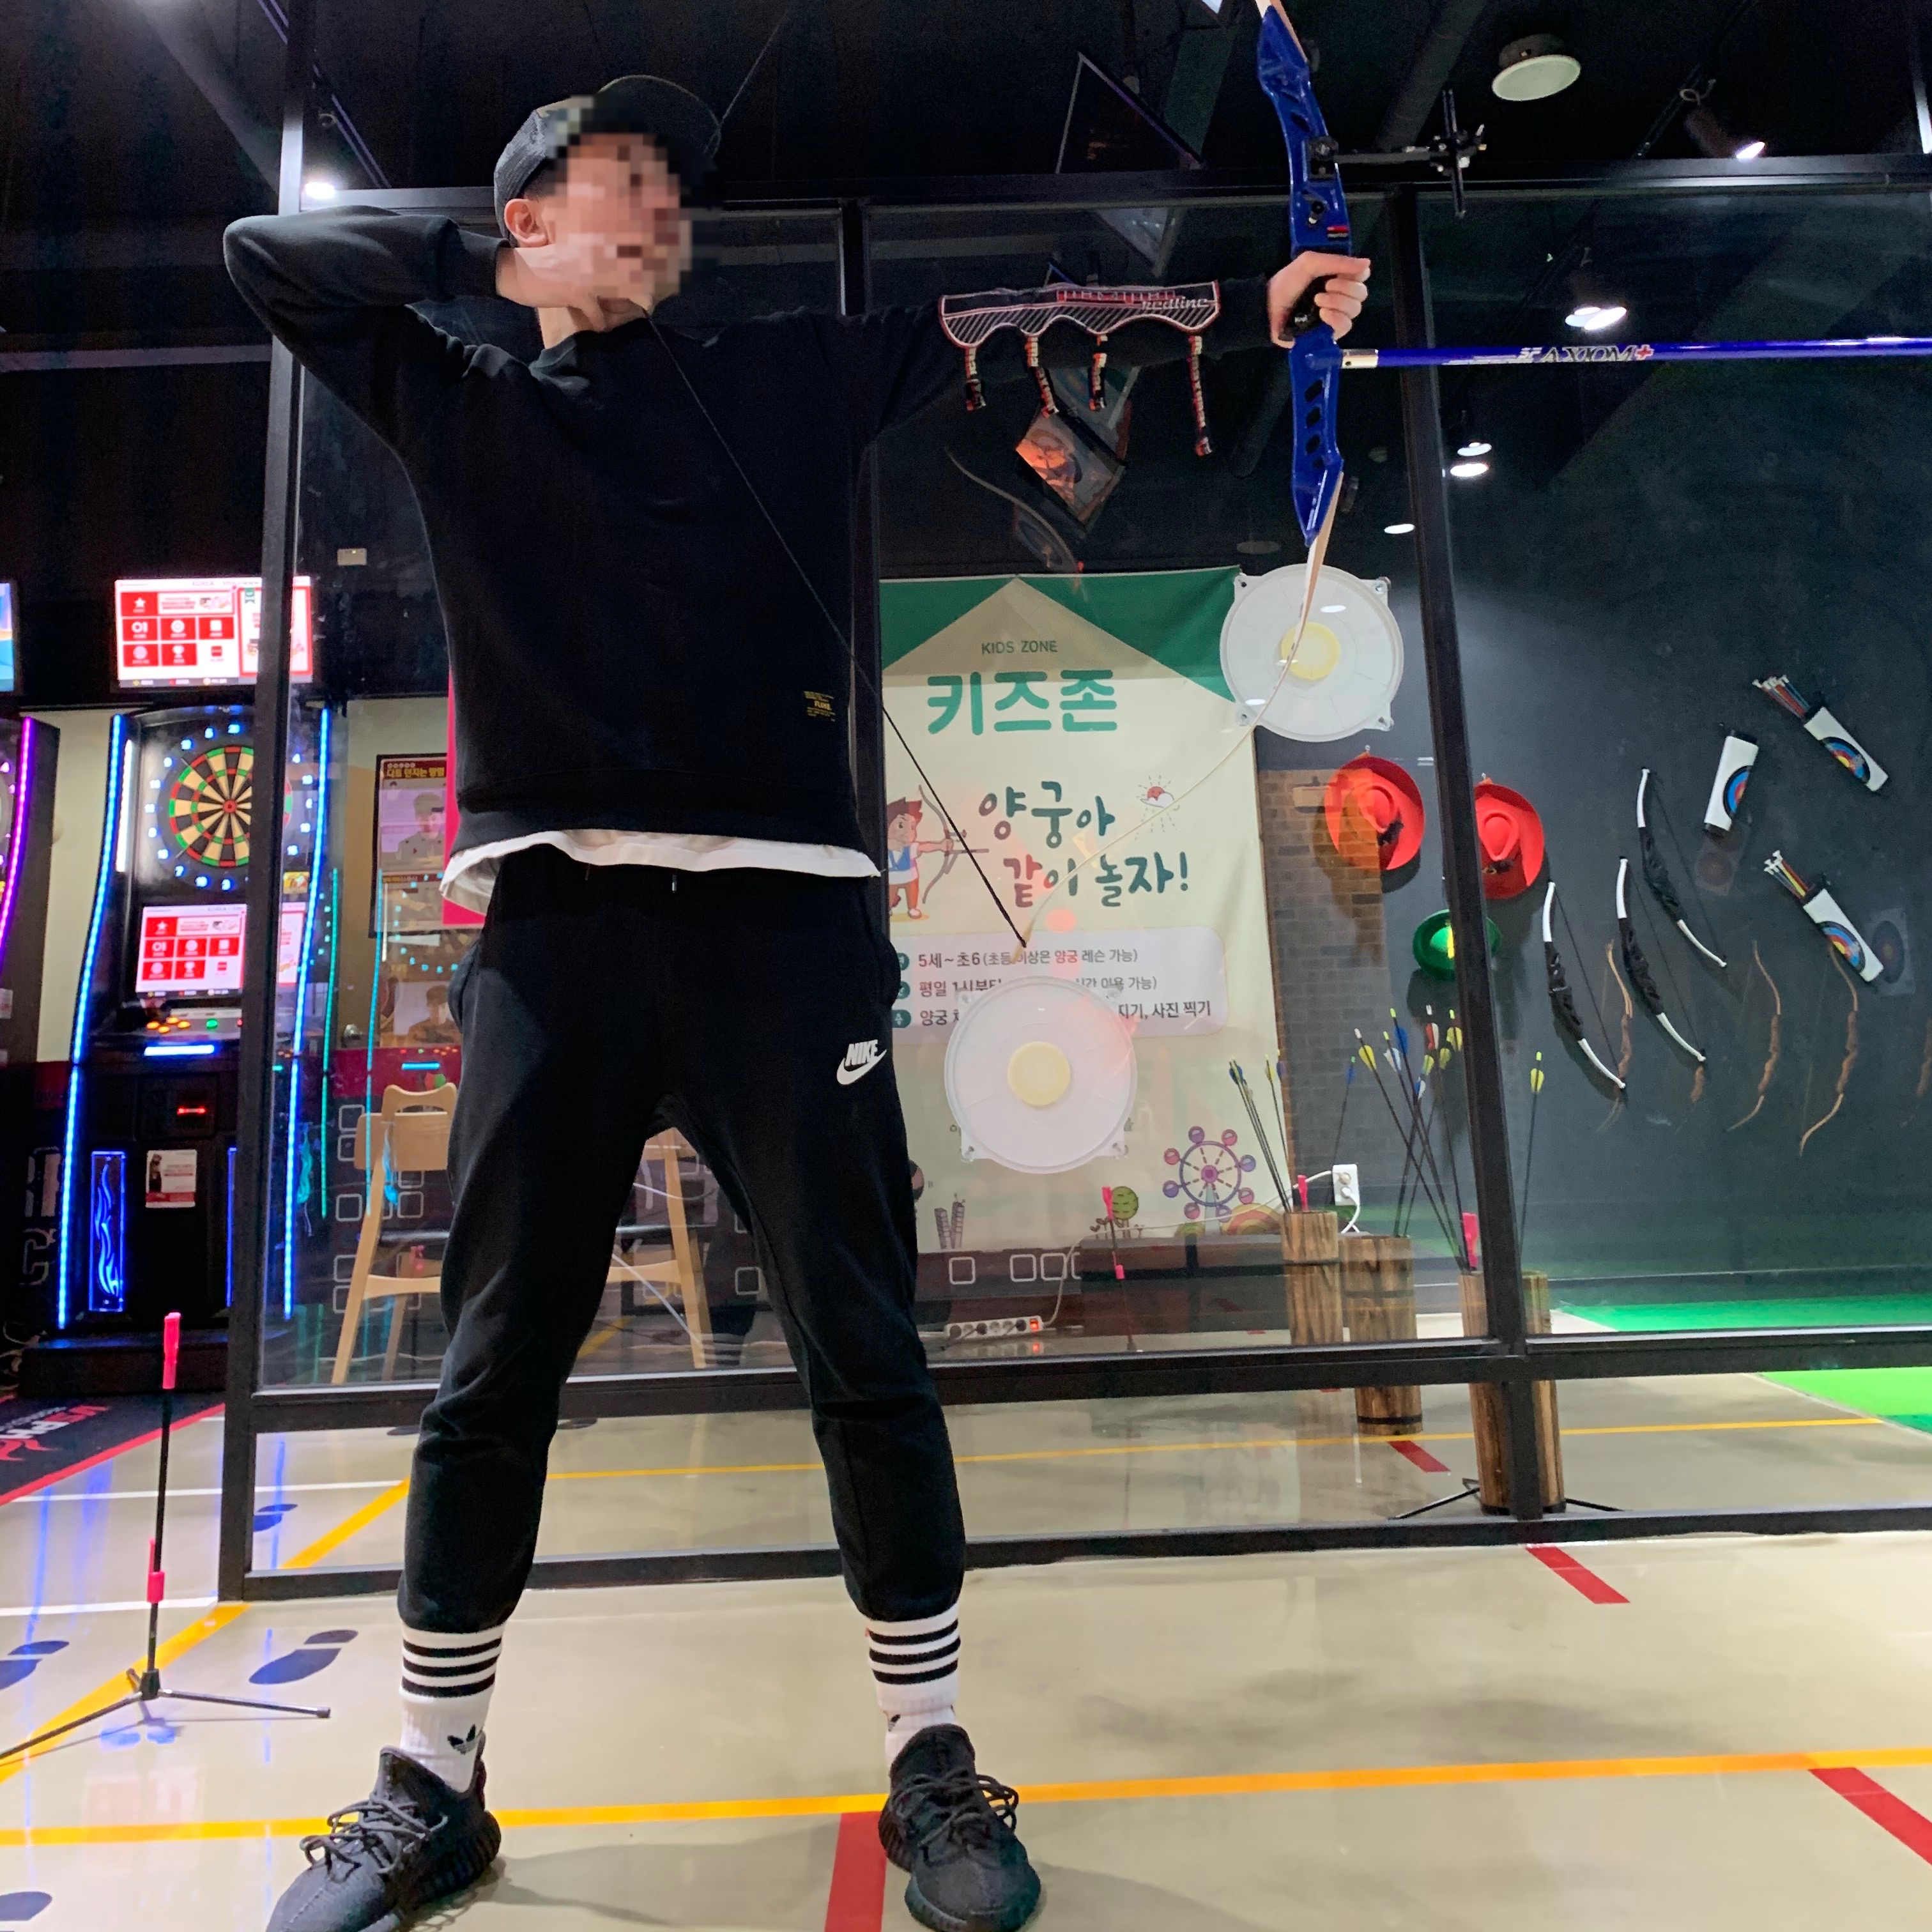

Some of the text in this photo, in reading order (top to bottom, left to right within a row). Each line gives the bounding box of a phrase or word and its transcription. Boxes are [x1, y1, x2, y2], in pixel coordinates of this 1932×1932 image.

[981, 640, 1058, 654] KIDS ZONE
[927, 669, 1117, 736] 키즈존
[979, 781, 1116, 848] 양궁아
[1003, 852, 1188, 908] 같이 놀자!
[1054, 949, 1078, 964] 양궁
[1081, 949, 1105, 963] 레슨
[1109, 948, 1138, 963] 가능)
[919, 981, 947, 997] 평일
[1128, 976, 1158, 990] 가능)
[919, 1009, 947, 1026] 양궁
[1151, 1001, 1179, 1019] 사진
[1183, 1000, 1211, 1017] 찍기
[845, 1039, 878, 1066] NIKE
